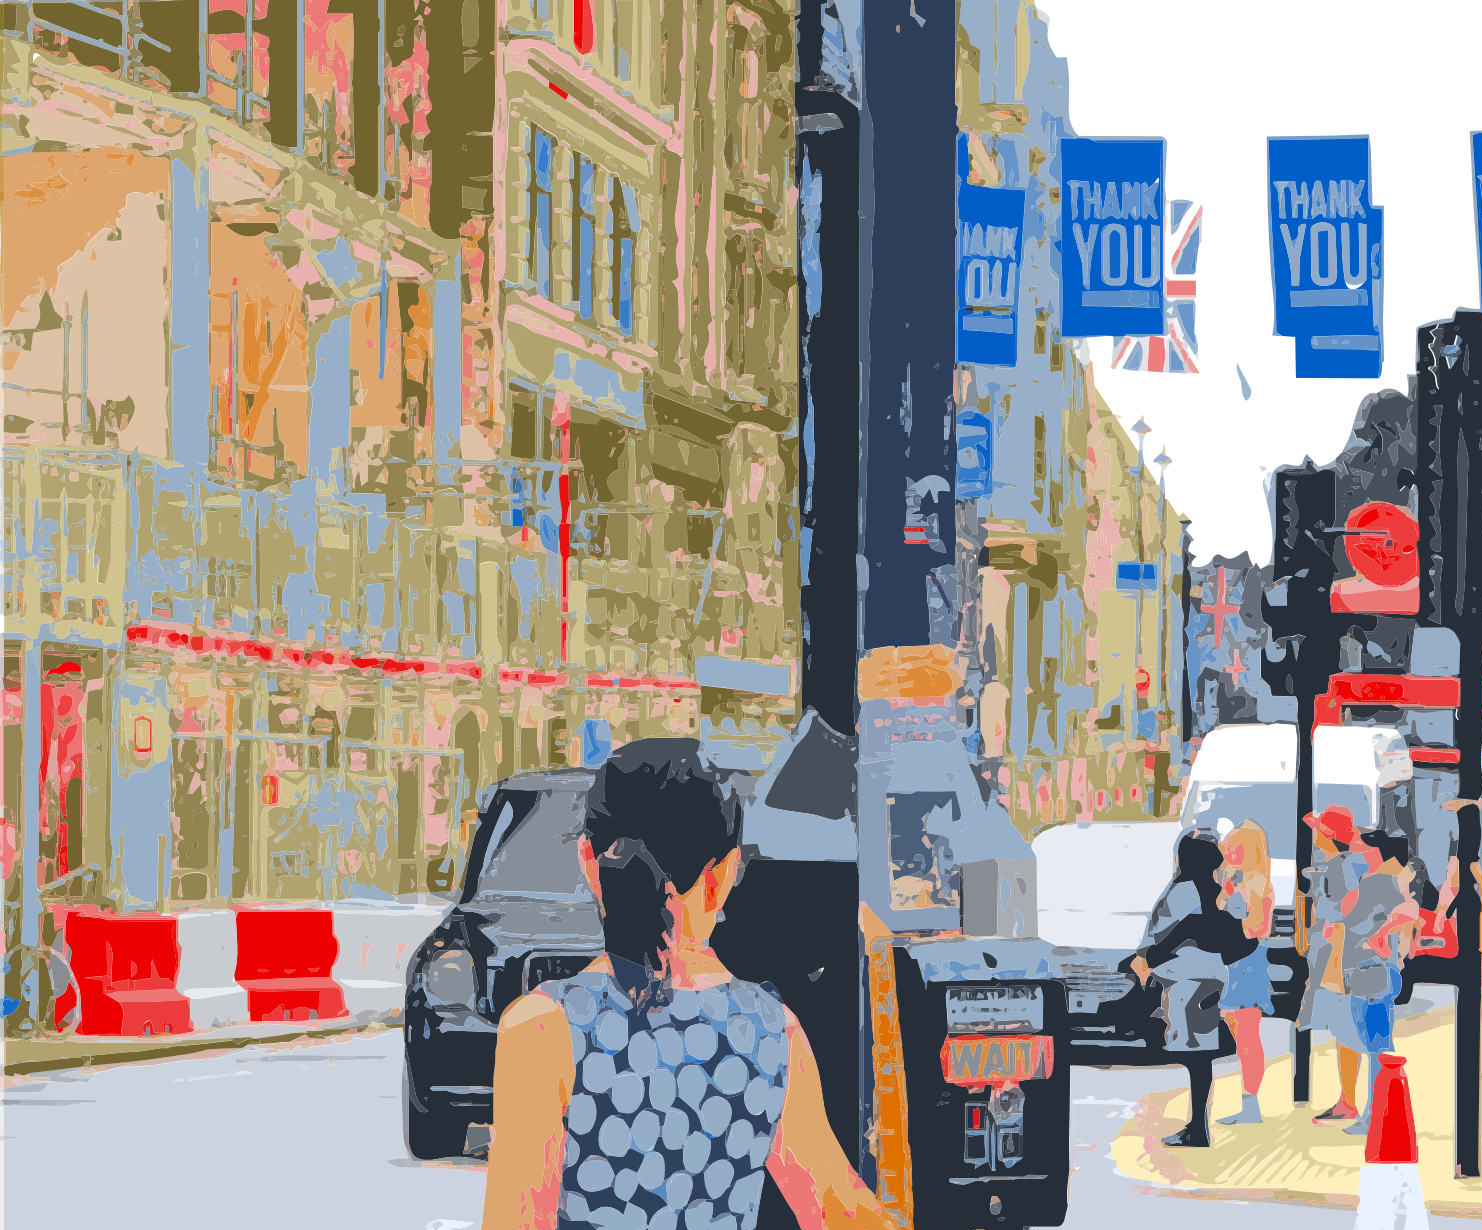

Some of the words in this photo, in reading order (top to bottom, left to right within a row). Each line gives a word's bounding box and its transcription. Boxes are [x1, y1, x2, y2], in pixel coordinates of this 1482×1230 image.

[1067, 179, 1160, 221] THANK
[1273, 180, 1367, 220] THANK
[1072, 222, 1161, 291] YOU
[1280, 221, 1368, 287] YOU
[964, 259, 1017, 306] OU
[950, 1041, 1032, 1078] WAIT
